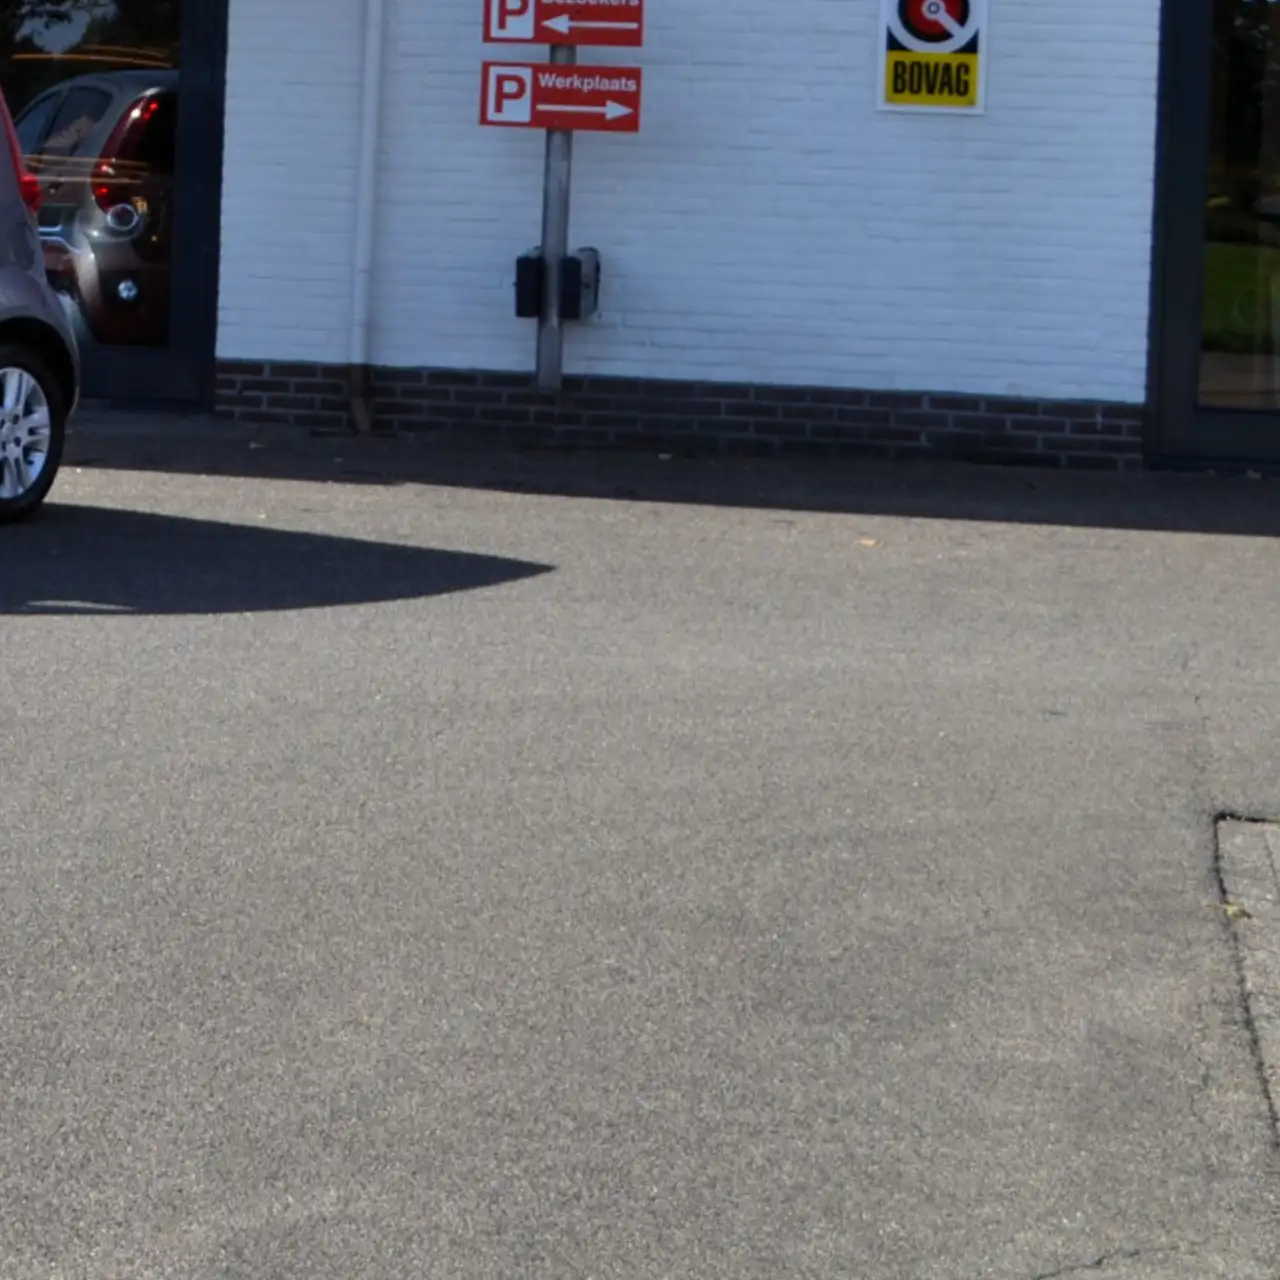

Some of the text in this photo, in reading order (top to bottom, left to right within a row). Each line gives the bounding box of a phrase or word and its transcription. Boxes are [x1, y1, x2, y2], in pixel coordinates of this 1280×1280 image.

[494, 72, 637, 114] P Werkplaats
[893, 60, 970, 97] BOVAG
